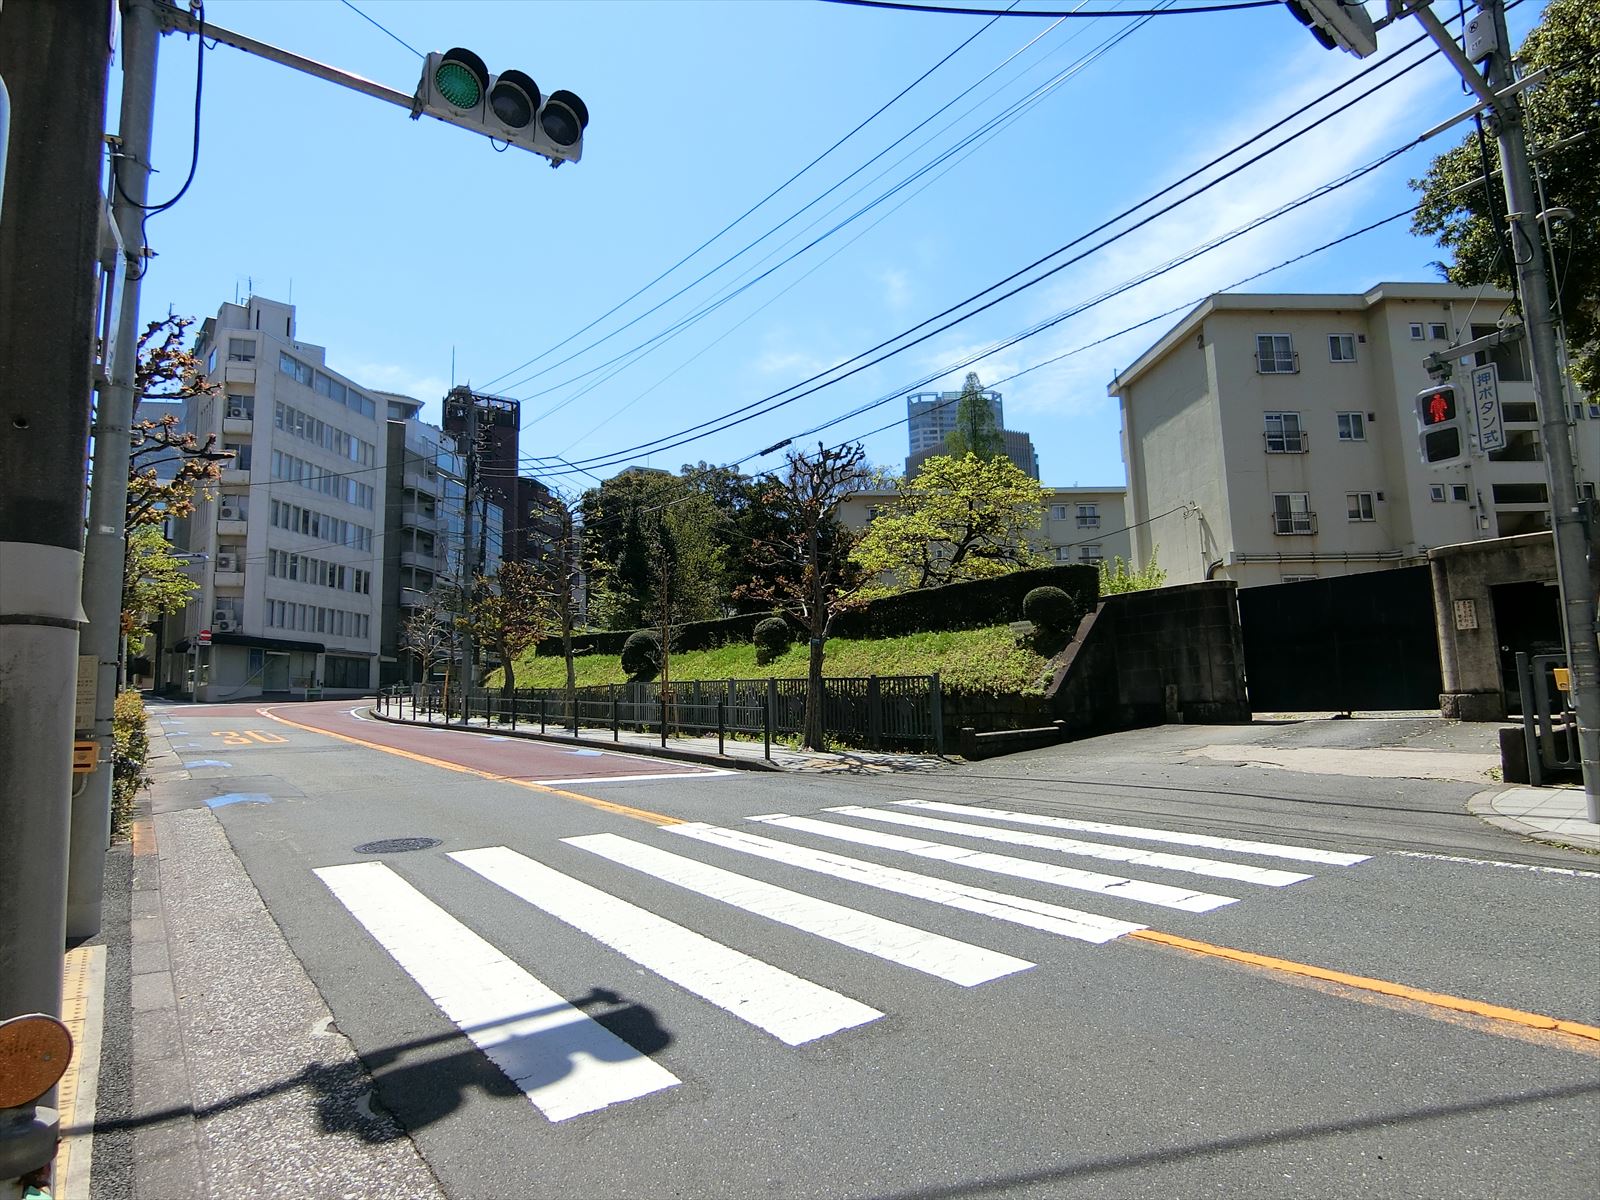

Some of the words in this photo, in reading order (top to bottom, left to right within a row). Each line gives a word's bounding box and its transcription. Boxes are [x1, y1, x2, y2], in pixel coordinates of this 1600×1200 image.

[1197, 334, 1205, 349] 2
[1477, 372, 1499, 444] 押ボタン式
[210, 729, 289, 745] 30
